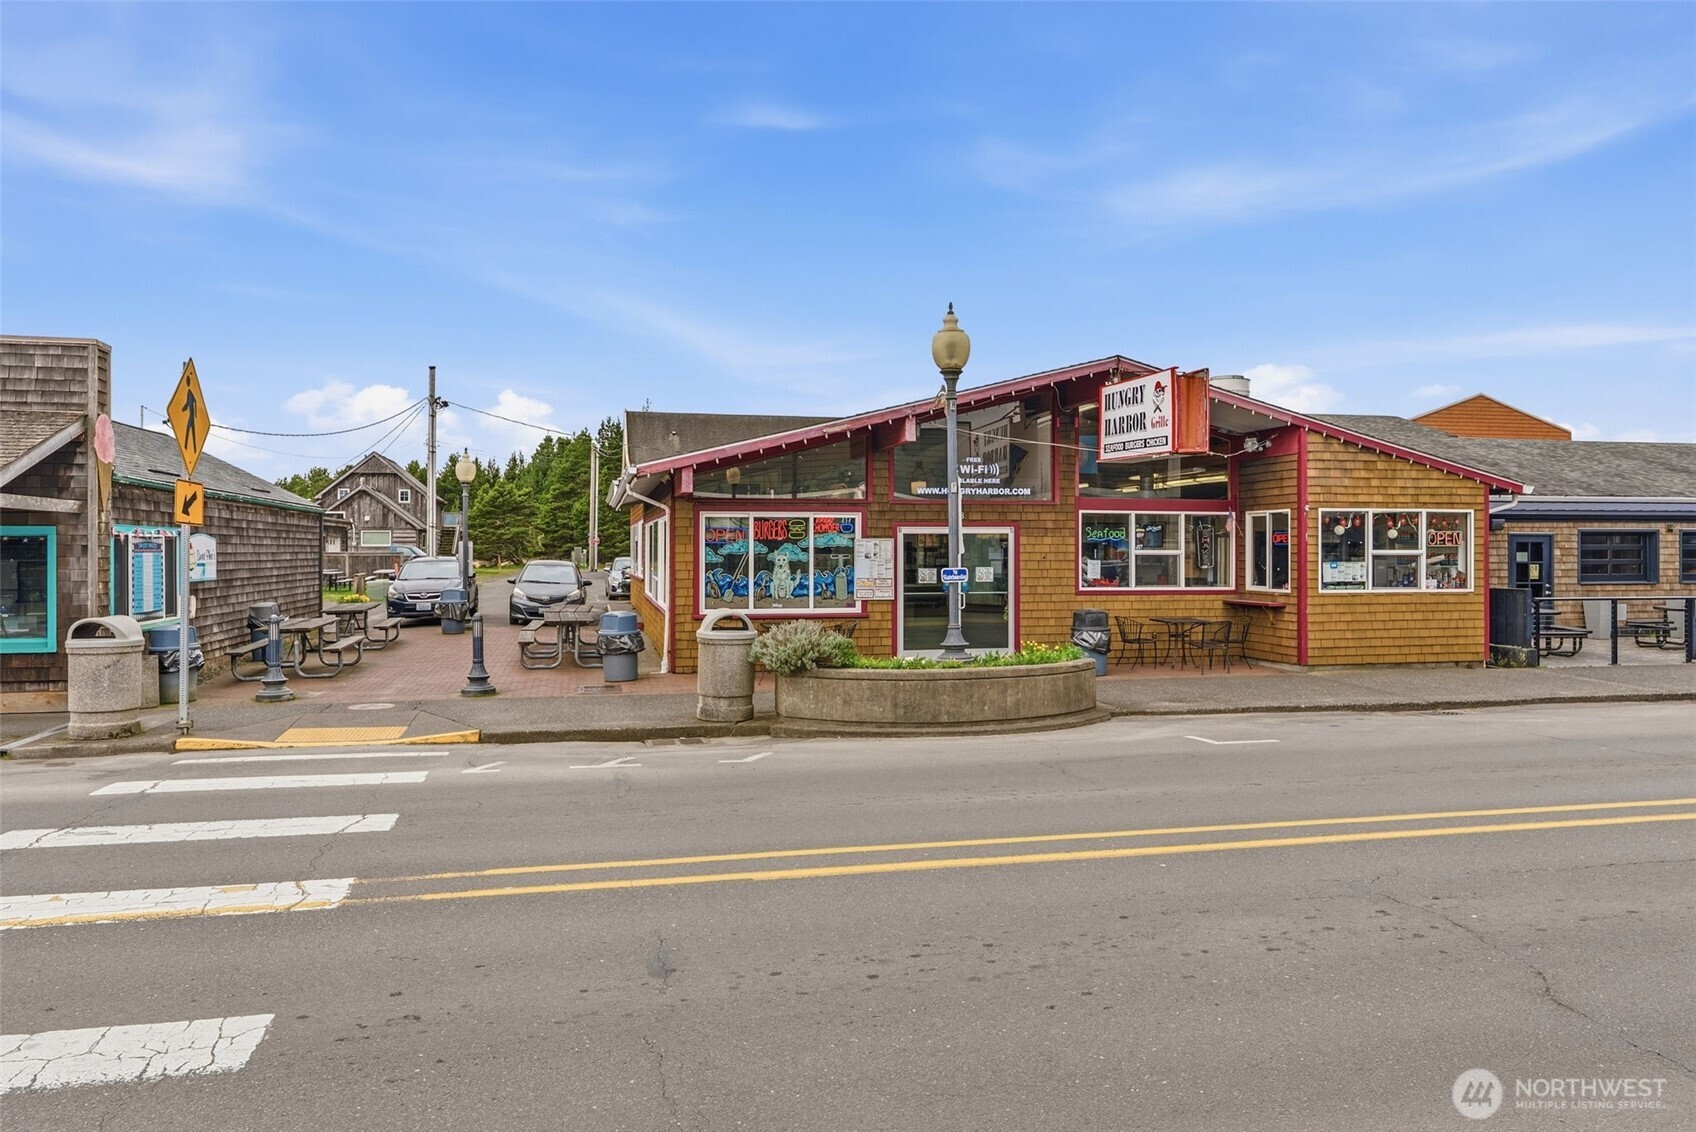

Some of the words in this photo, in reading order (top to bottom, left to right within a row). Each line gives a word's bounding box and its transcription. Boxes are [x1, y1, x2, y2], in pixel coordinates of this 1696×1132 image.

[1105, 384, 1146, 412] HUNGRY
[1104, 412, 1147, 437] HARBOR
[1150, 415, 1169, 430] Grille
[1105, 443, 1124, 452] SEAFOOD
[1125, 440, 1145, 450] BURGERS
[1146, 437, 1166, 447] CHICKEN
[960, 464, 988, 474] Wi-Fi
[917, 487, 1031, 495] WWW.HGRYHARBOR.COM
[705, 528, 746, 542] OPEN
[754, 520, 788, 540] BURGERS
[1085, 526, 1125, 539] Seafood
[1428, 532, 1461, 545] OPEN
